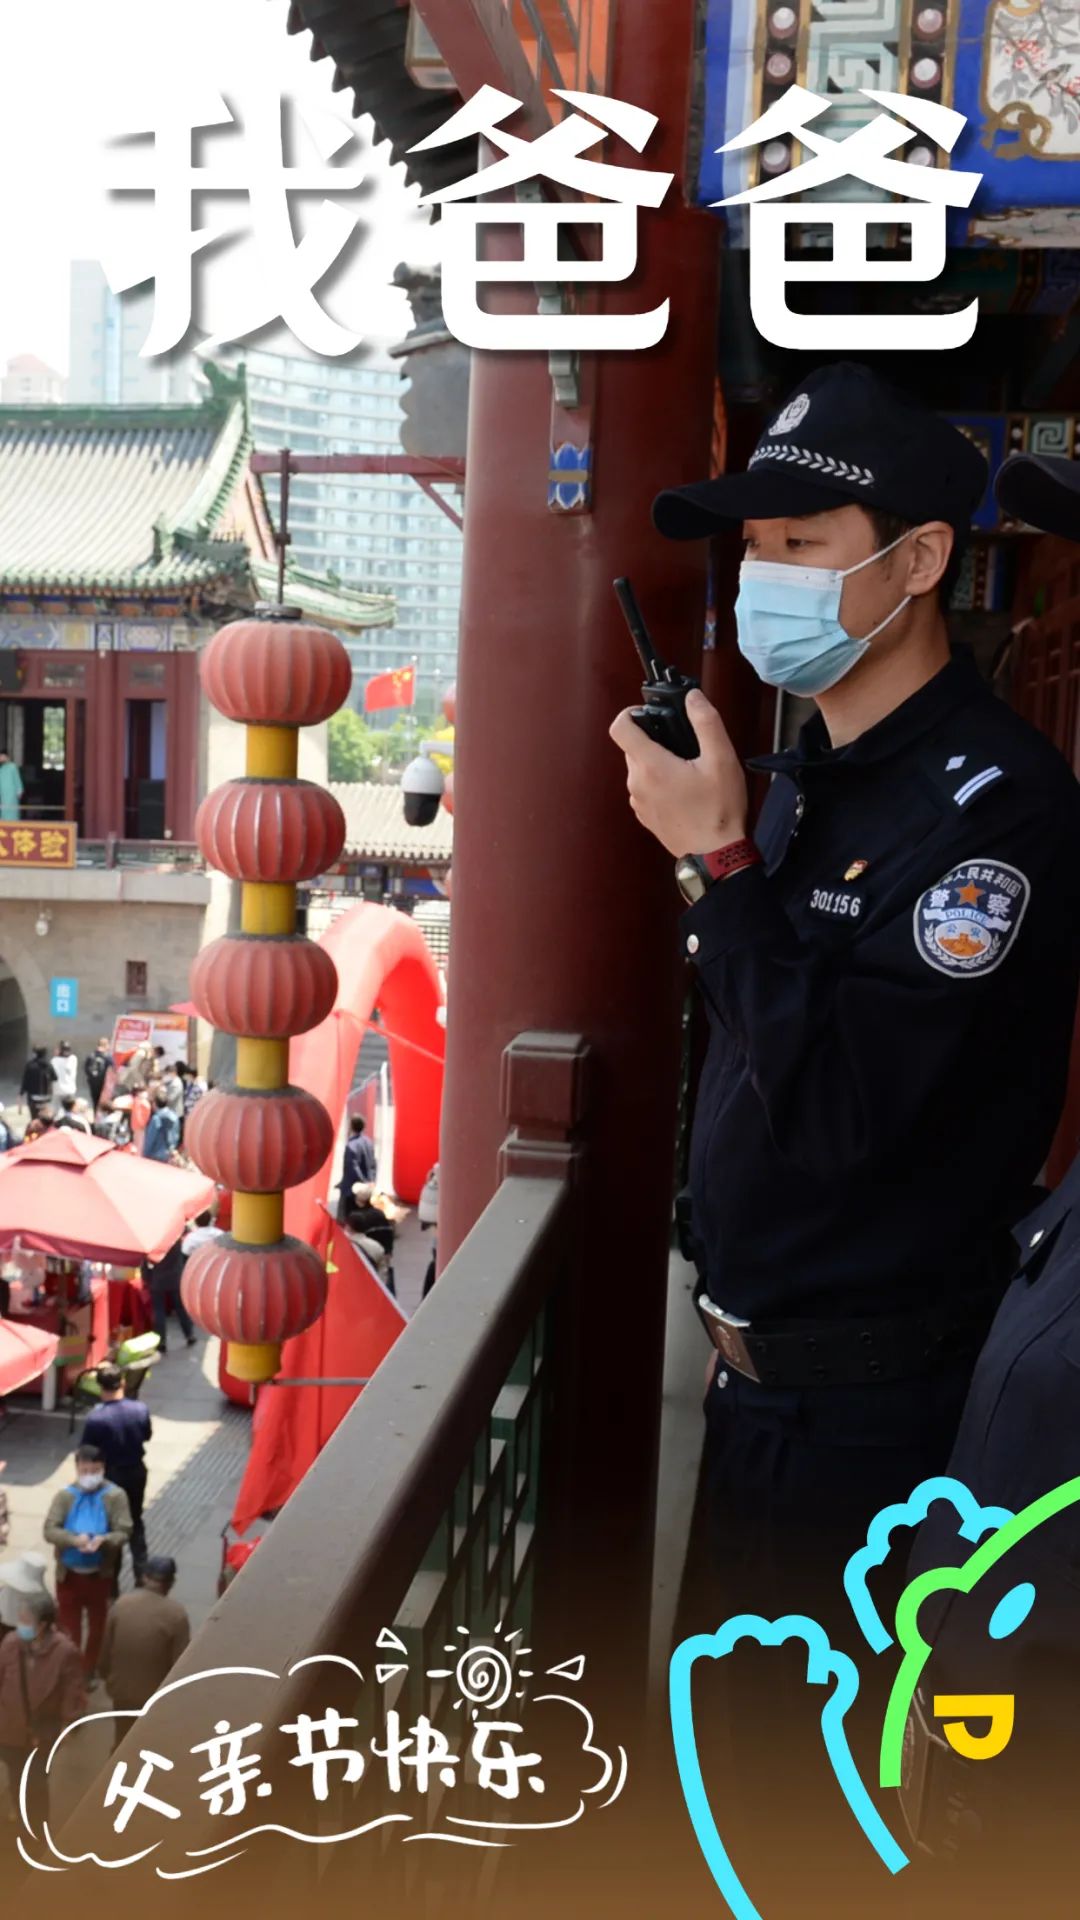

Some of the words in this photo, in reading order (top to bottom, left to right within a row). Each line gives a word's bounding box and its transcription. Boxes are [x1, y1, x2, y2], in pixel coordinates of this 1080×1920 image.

[930, 866, 1022, 898] 华人民共和国
[810, 888, 861, 917] 301156
[945, 908, 988, 925] POLICE
